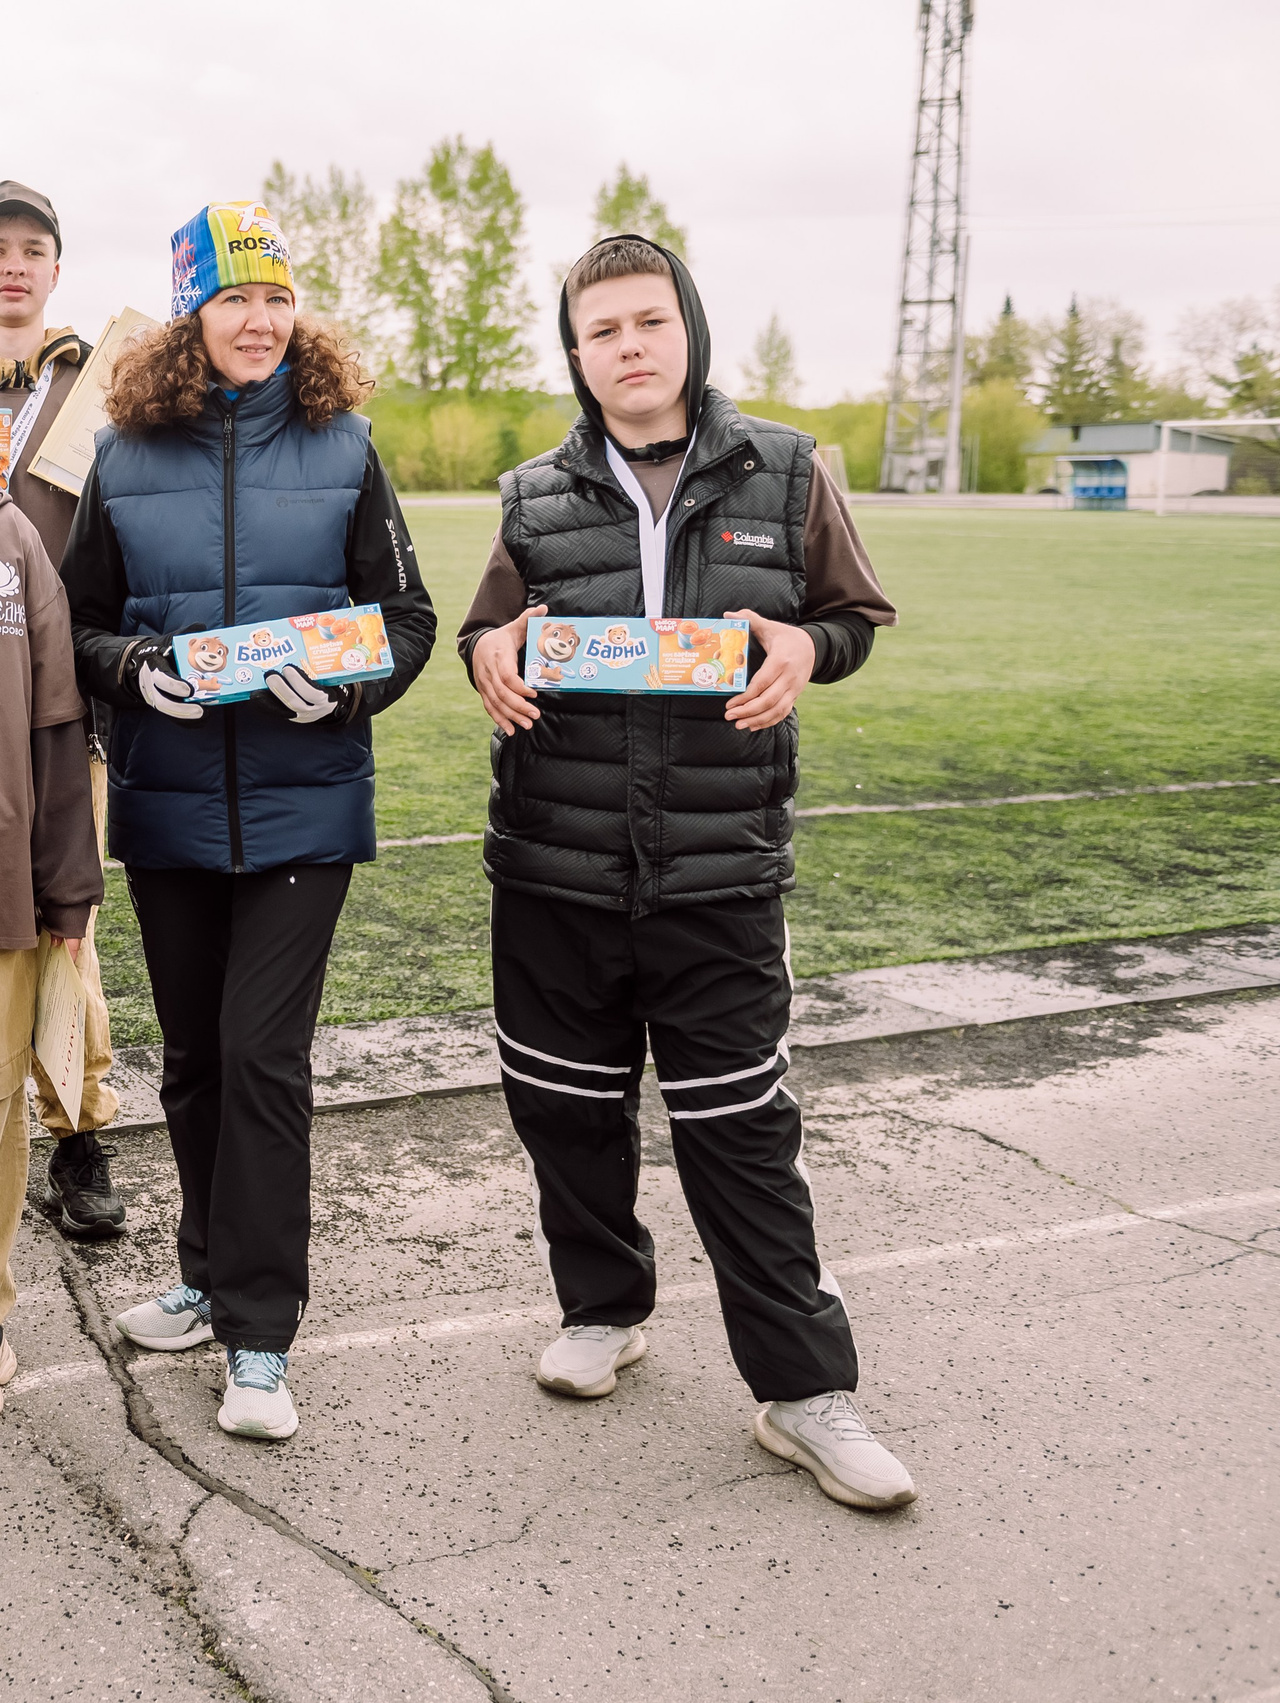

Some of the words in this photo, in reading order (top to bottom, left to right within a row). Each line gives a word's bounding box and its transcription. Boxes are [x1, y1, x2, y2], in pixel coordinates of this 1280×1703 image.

[733, 531, 774, 545] Columbia
[385, 519, 407, 592] SALOMON
[237, 639, 294, 662] Барни
[586, 638, 647, 660] Барни
[586, 666, 592, 675] 3
